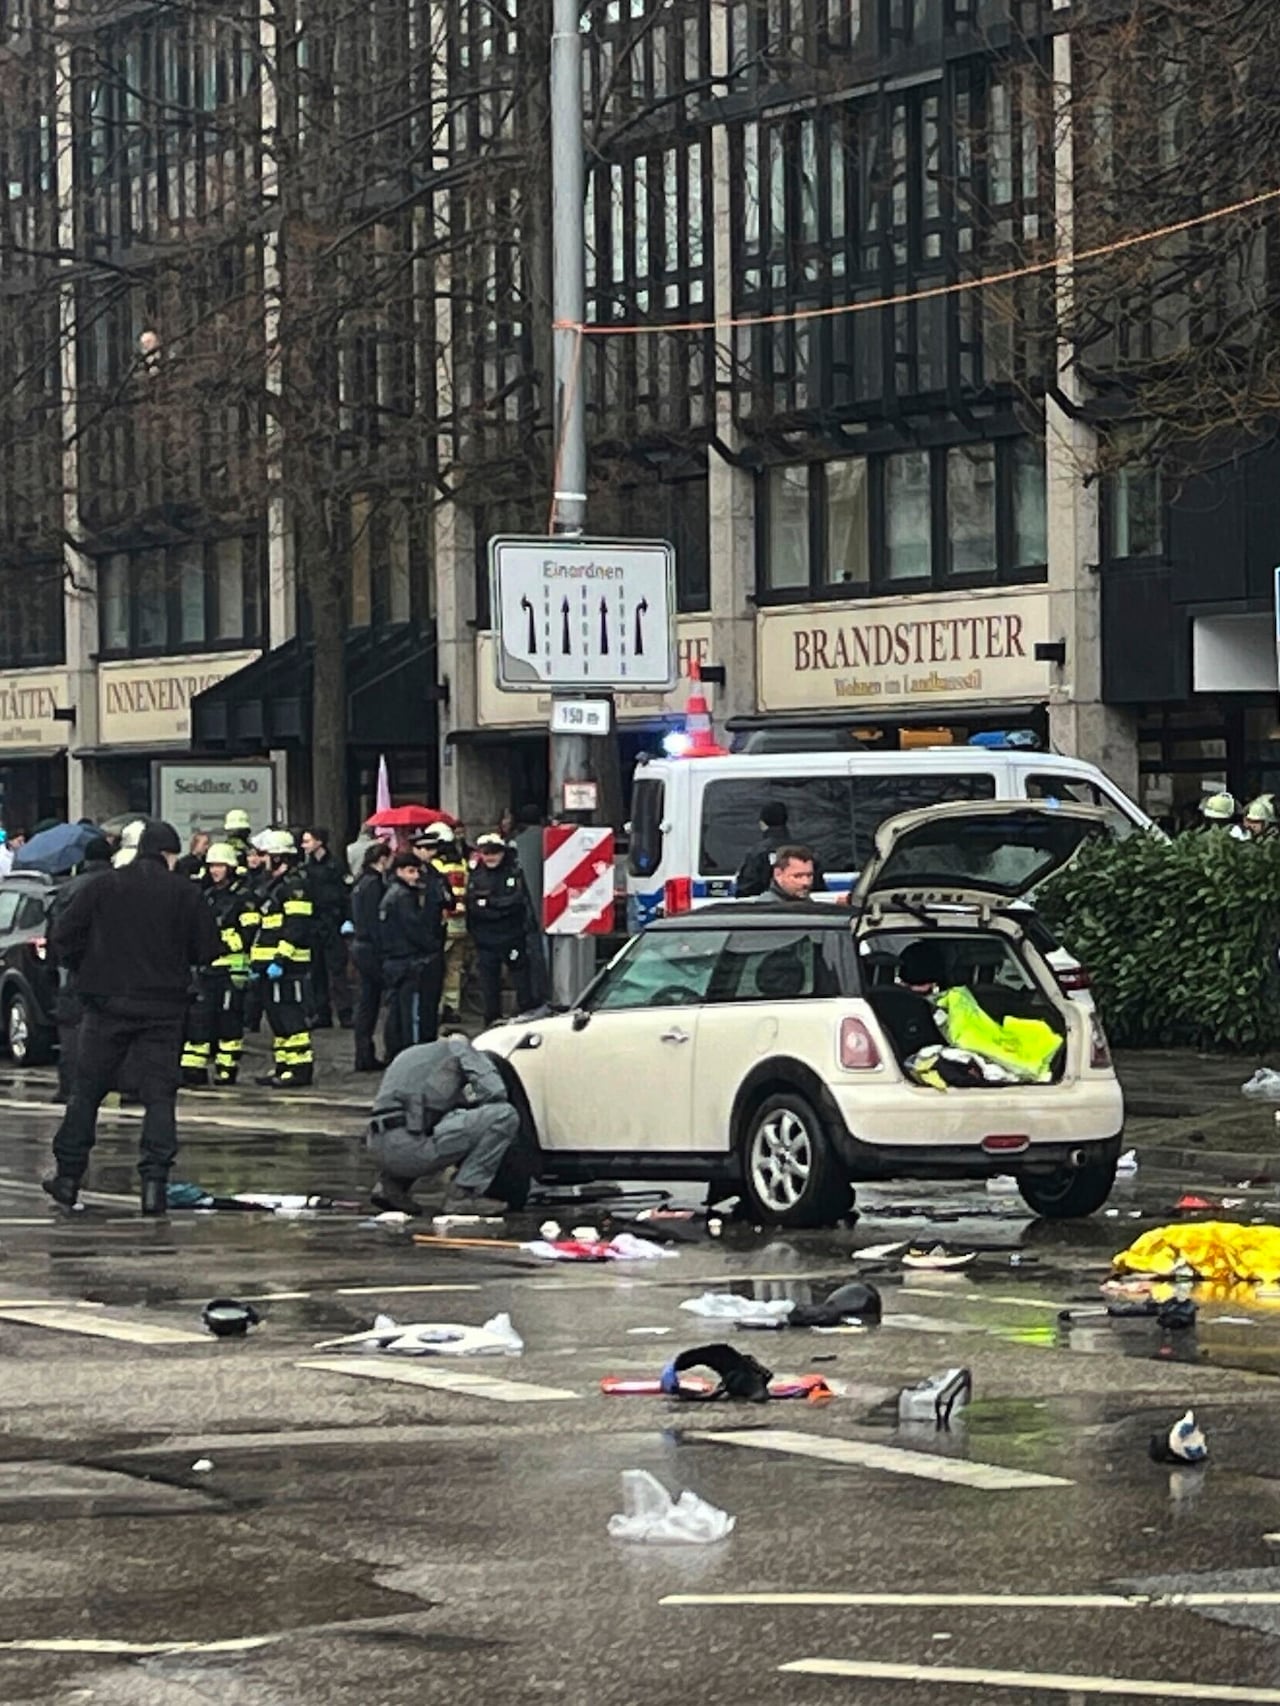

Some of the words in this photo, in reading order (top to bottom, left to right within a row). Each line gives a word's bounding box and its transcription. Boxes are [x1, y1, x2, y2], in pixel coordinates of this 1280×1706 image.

[542, 561, 624, 580] Einordnen
[794, 614, 1027, 671] BRANDSTETTER
[562, 707, 583, 724] 150
[174, 778, 235, 795] Seidlstr.
[238, 778, 258, 794] 30
